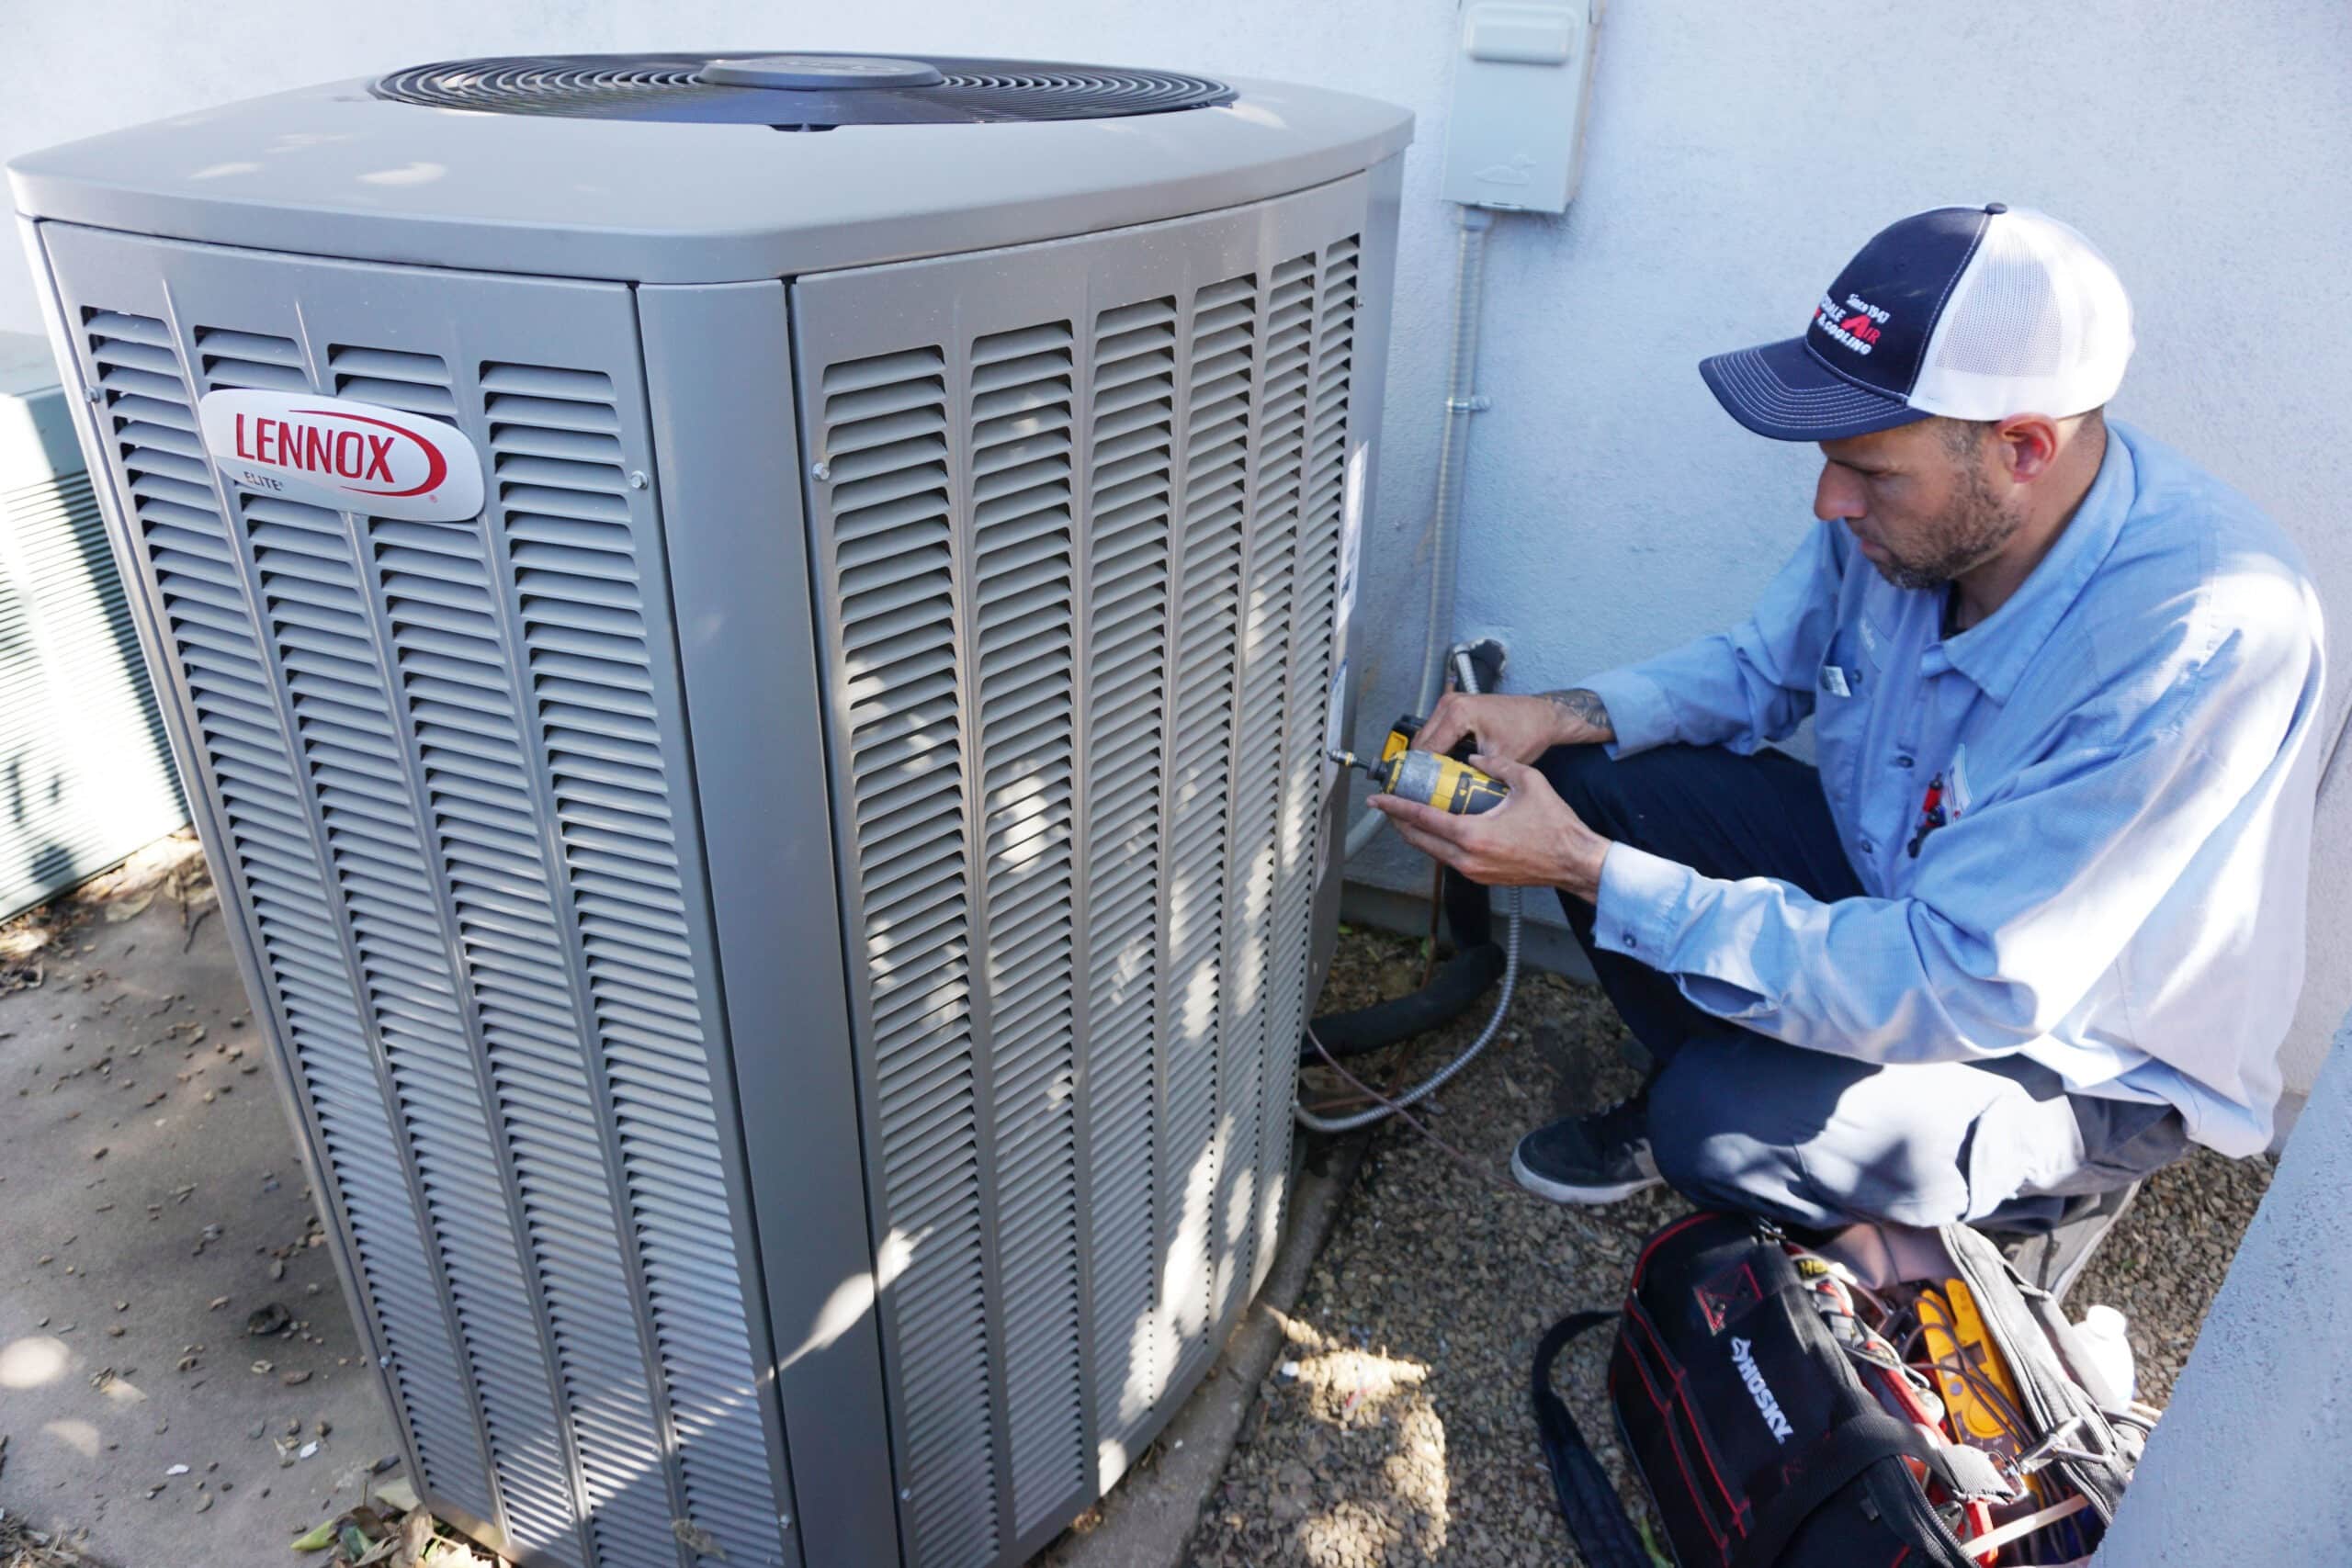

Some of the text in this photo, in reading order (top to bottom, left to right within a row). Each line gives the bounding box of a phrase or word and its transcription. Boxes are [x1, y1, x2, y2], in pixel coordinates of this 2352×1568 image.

[1846, 293, 1869, 313] Since
[1840, 314, 1881, 344] AIR
[236, 413, 395, 483] LENNOX
[243, 470, 281, 491] ELITE
[1736, 1356, 1793, 1439] HUSKY
